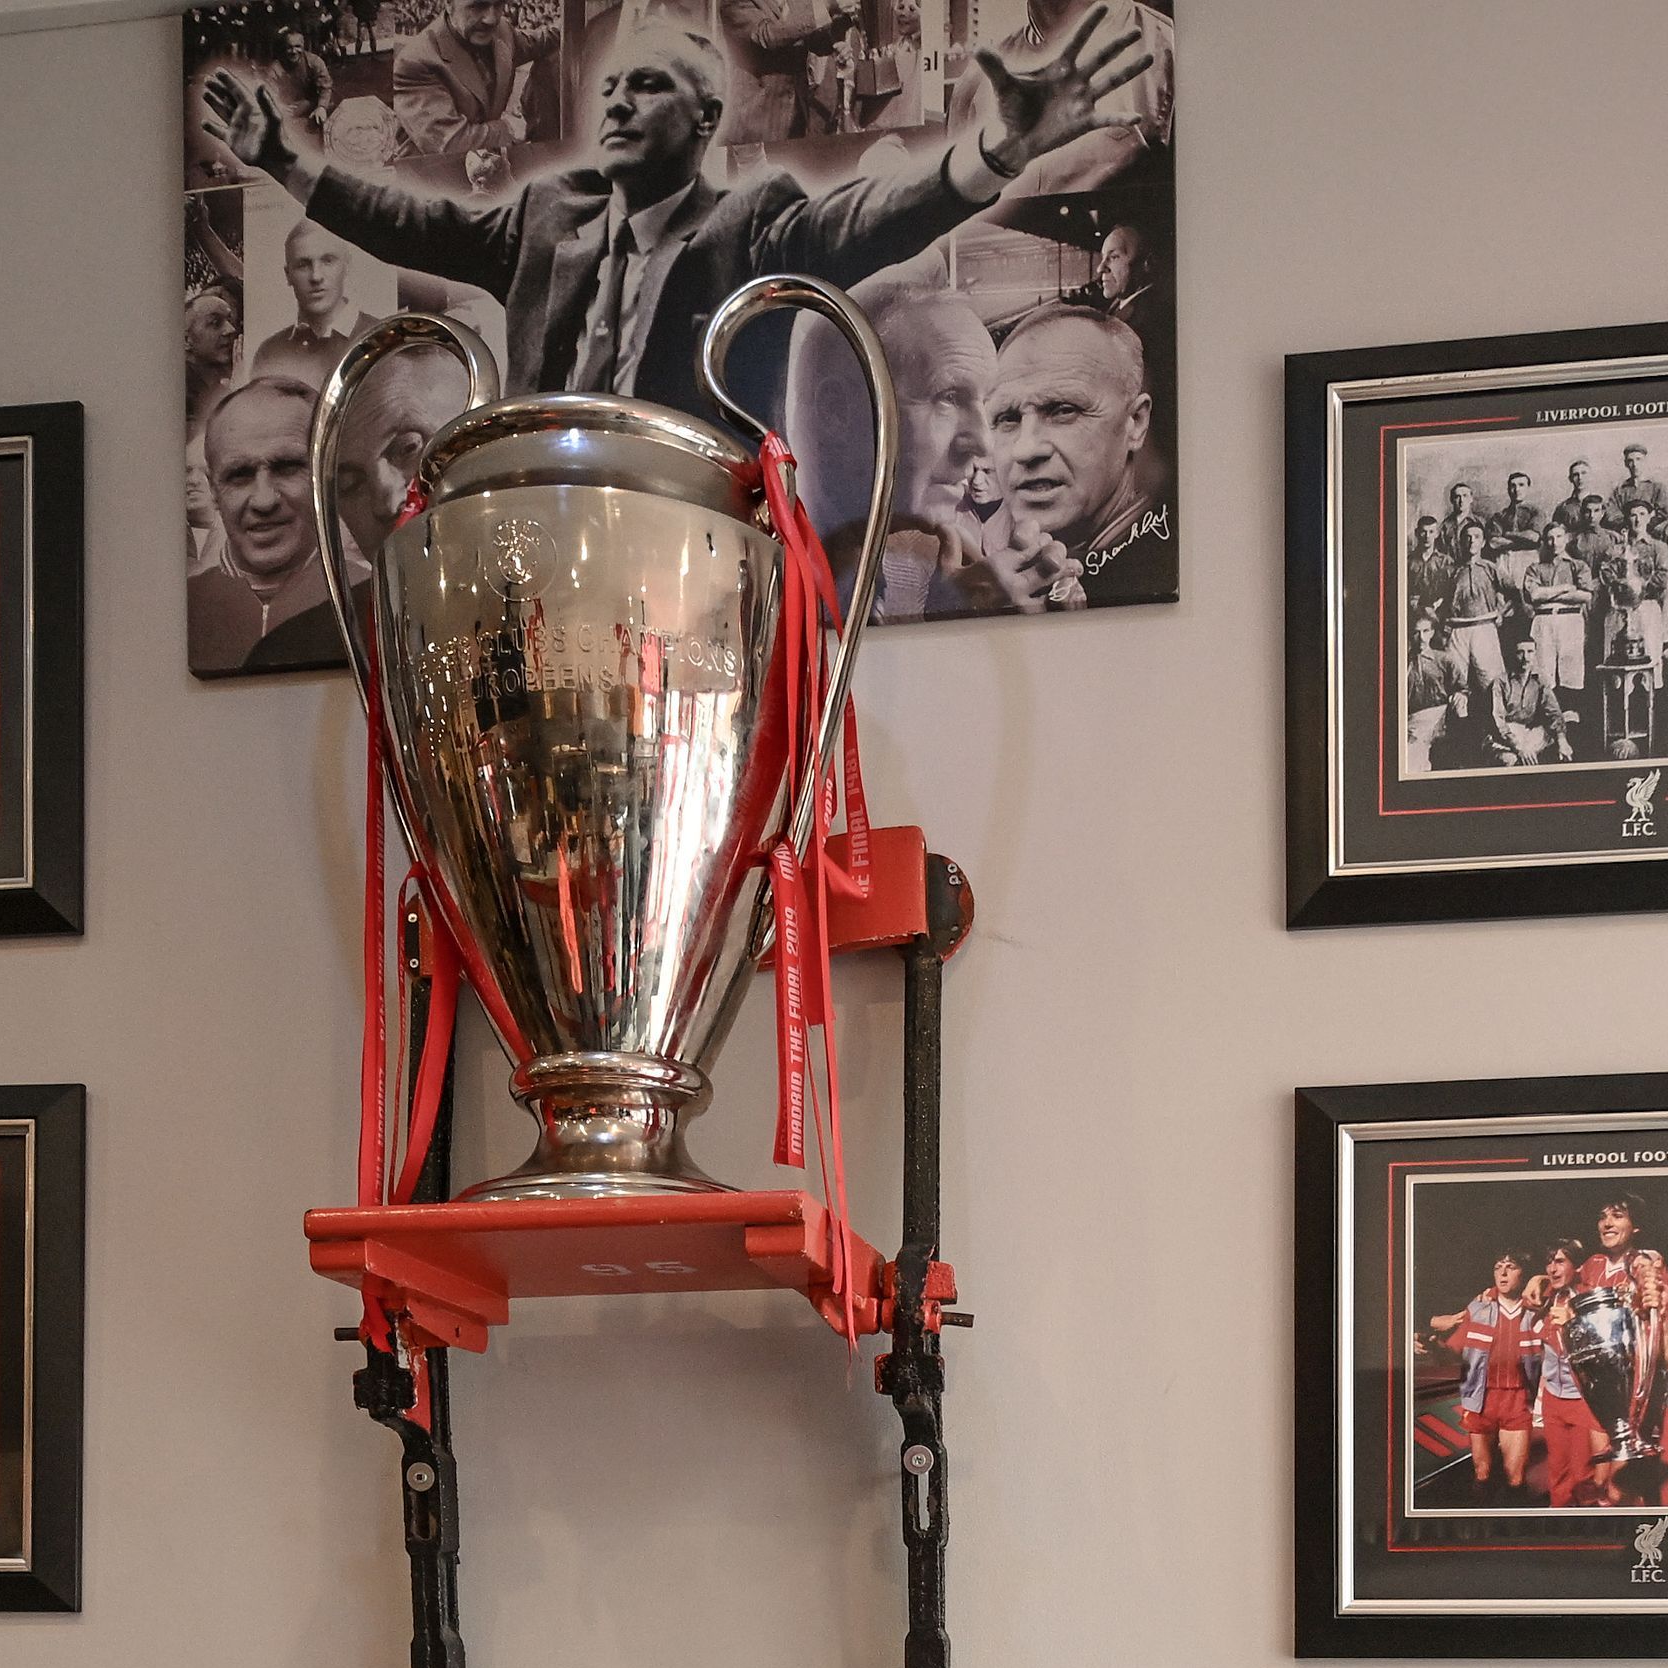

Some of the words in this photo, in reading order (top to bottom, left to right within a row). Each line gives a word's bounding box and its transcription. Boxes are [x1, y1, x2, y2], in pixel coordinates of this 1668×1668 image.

[1536, 403, 1621, 423] LIVERPOOL
[850, 803, 870, 868] FINAL
[785, 905, 800, 955] 2019
[789, 970, 803, 1020] FINAL
[790, 1024, 804, 1064] THE
[791, 1071, 804, 1155] MADRID
[1542, 1150, 1629, 1167] LIVERPOOL
